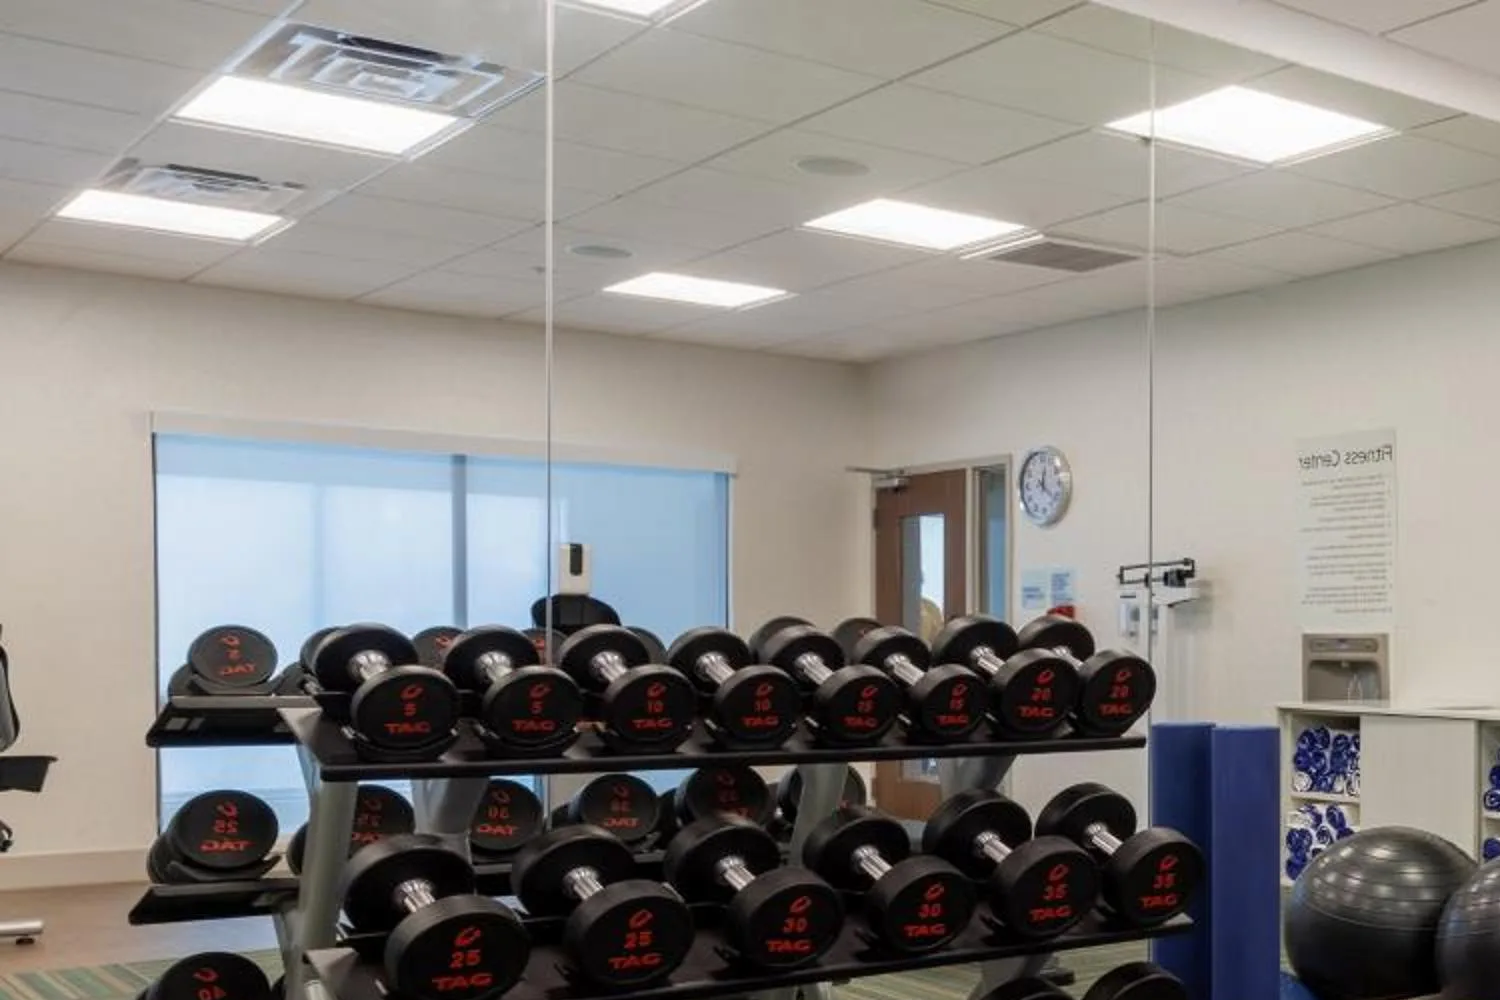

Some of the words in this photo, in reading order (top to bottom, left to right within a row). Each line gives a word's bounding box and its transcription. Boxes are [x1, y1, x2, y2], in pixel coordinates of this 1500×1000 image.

[404, 704, 416, 716] 5
[531, 701, 542, 713] 5
[1020, 705, 1053, 718] TAG
[1100, 702, 1131, 714] TAG
[511, 719, 554, 731] TAG
[632, 718, 672, 729] TAG
[740, 715, 779, 728] TAG
[844, 716, 876, 728] TAG
[937, 715, 968, 726] TAG
[384, 722, 430, 734] TAG
[1153, 873, 1174, 888] 35
[1043, 884, 1068, 900] 35
[1142, 893, 1178, 908] TAG
[918, 903, 941, 918] 30
[1029, 905, 1073, 922] TAG
[783, 918, 807, 933] 30
[904, 923, 945, 937] TAG
[625, 932, 652, 949] 25
[765, 938, 811, 954] TAG
[450, 950, 480, 968] 25
[608, 953, 663, 970] TAG
[432, 973, 492, 991] TAG
